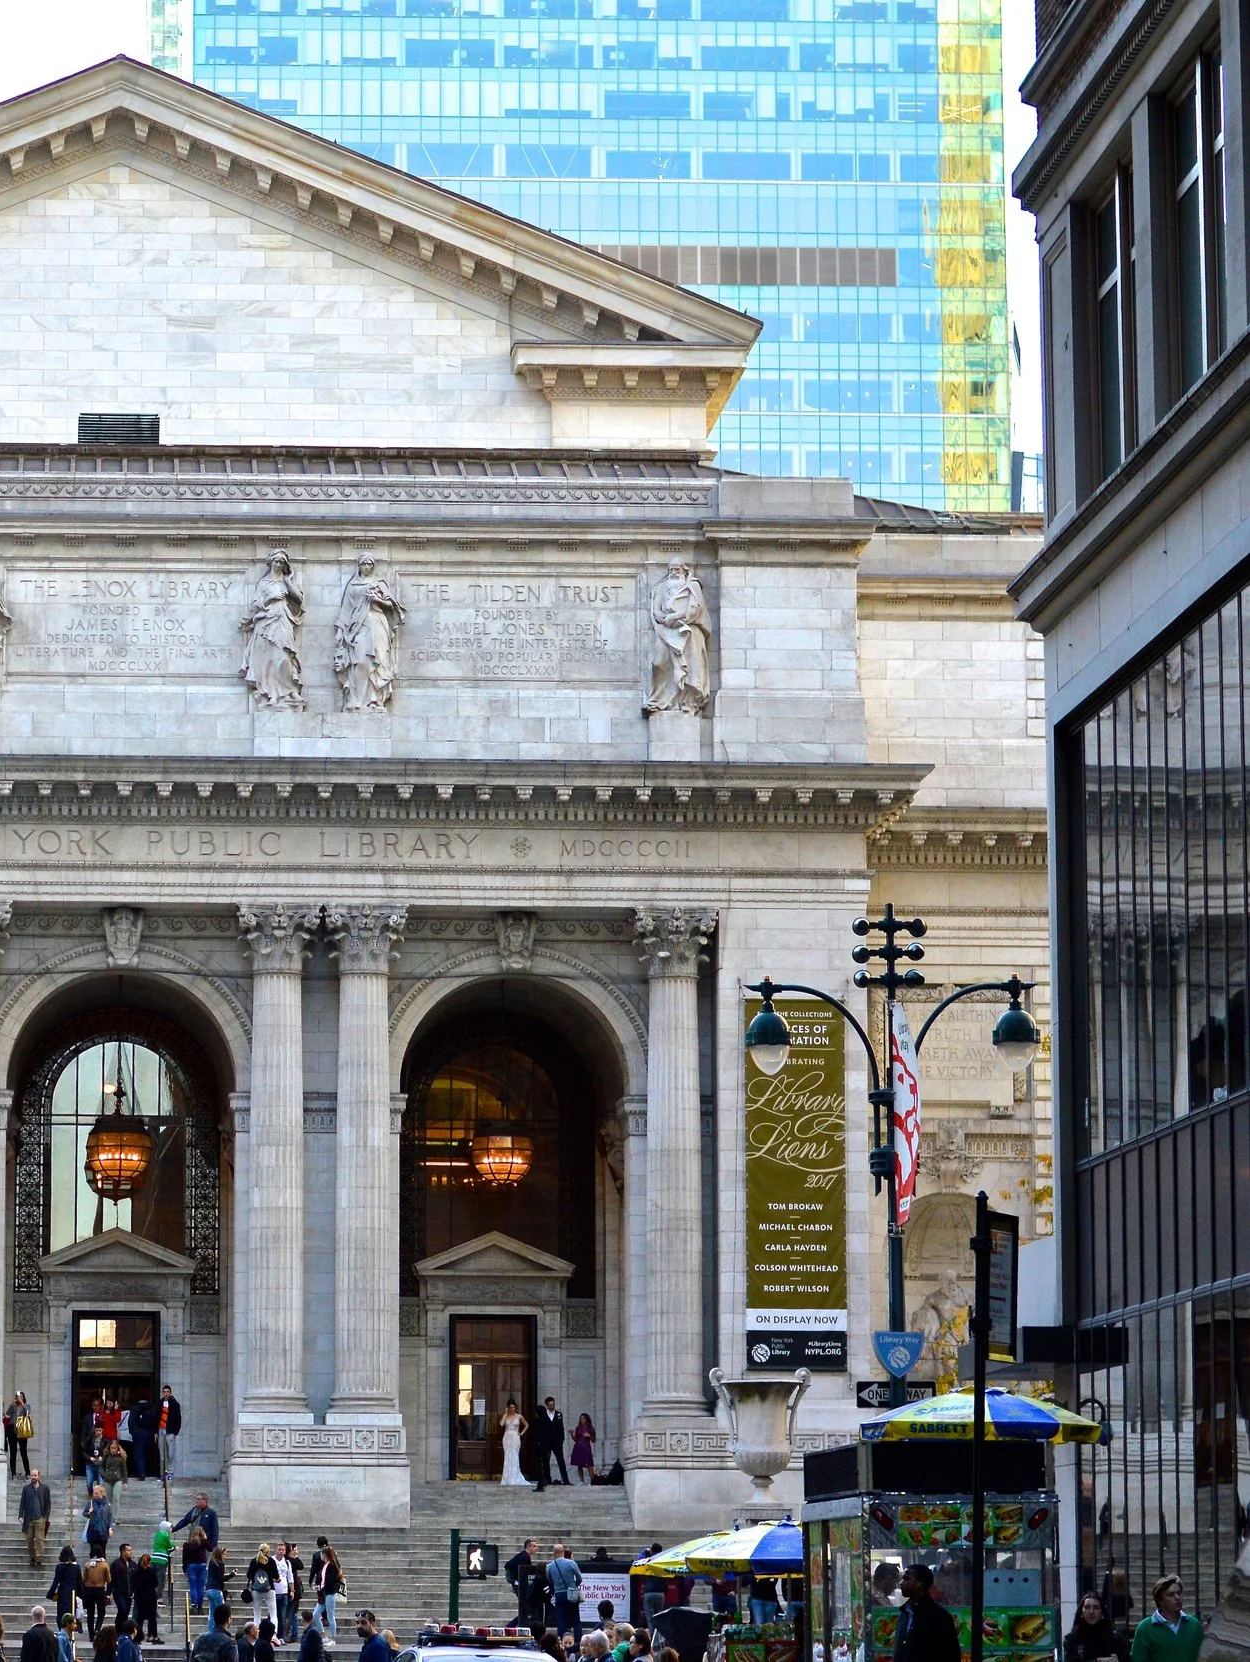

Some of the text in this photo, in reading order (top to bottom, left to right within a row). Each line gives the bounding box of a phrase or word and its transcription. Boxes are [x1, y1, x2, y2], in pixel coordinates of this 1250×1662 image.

[20, 580, 232, 599] THE LENOX LIBRARY
[412, 584, 624, 603] THE TILDEN TRUST
[82, 606, 169, 616] FOUNDED BY
[475, 610, 560, 621] FOUNDED BY
[66, 618, 185, 631] JAMES LENOX
[434, 622, 602, 636] SAMUEL JONES TILDEN
[47, 634, 204, 645] DEDICATED TO HISTORY
[425, 637, 609, 649] TO SERVE THE INTERESTS OF
[15, 647, 232, 659] LITERATURE AND THE FINE ARTS
[410, 651, 627, 663] SCIENCE AND POPULAR EDUCATION
[12, 828, 114, 856] YORK
[146, 830, 282, 857] PUBLIC
[318, 831, 484, 860] LIBRARY
[813, 1025, 827, 1034] OF
[790, 1036, 829, 1045] RATION
[786, 1058, 825, 1066] BRATING
[937, 1066, 996, 1078] VICTORY
[746, 1071, 845, 1137] Library
[746, 1120, 845, 1172] Lions
[804, 1174, 838, 1190] 2017
[768, 1203, 824, 1211] TOM BROKAW
[758, 1223, 796, 1231] MICHAEL
[794, 1244, 827, 1252] HAYDEN
[789, 1264, 839, 1272] WHITEHEAD
[756, 1315, 838, 1324] ON DISPLAY NOW
[879, 1336, 920, 1344] Library Way
[772, 1349, 791, 1357] Library
[805, 1348, 842, 1356] NYPL.ORG
[868, 1389, 889, 1400] ONE
[909, 1422, 969, 1434] SABRETT
[611, 1584, 626, 1592] York
[601, 1592, 626, 1601] Library
